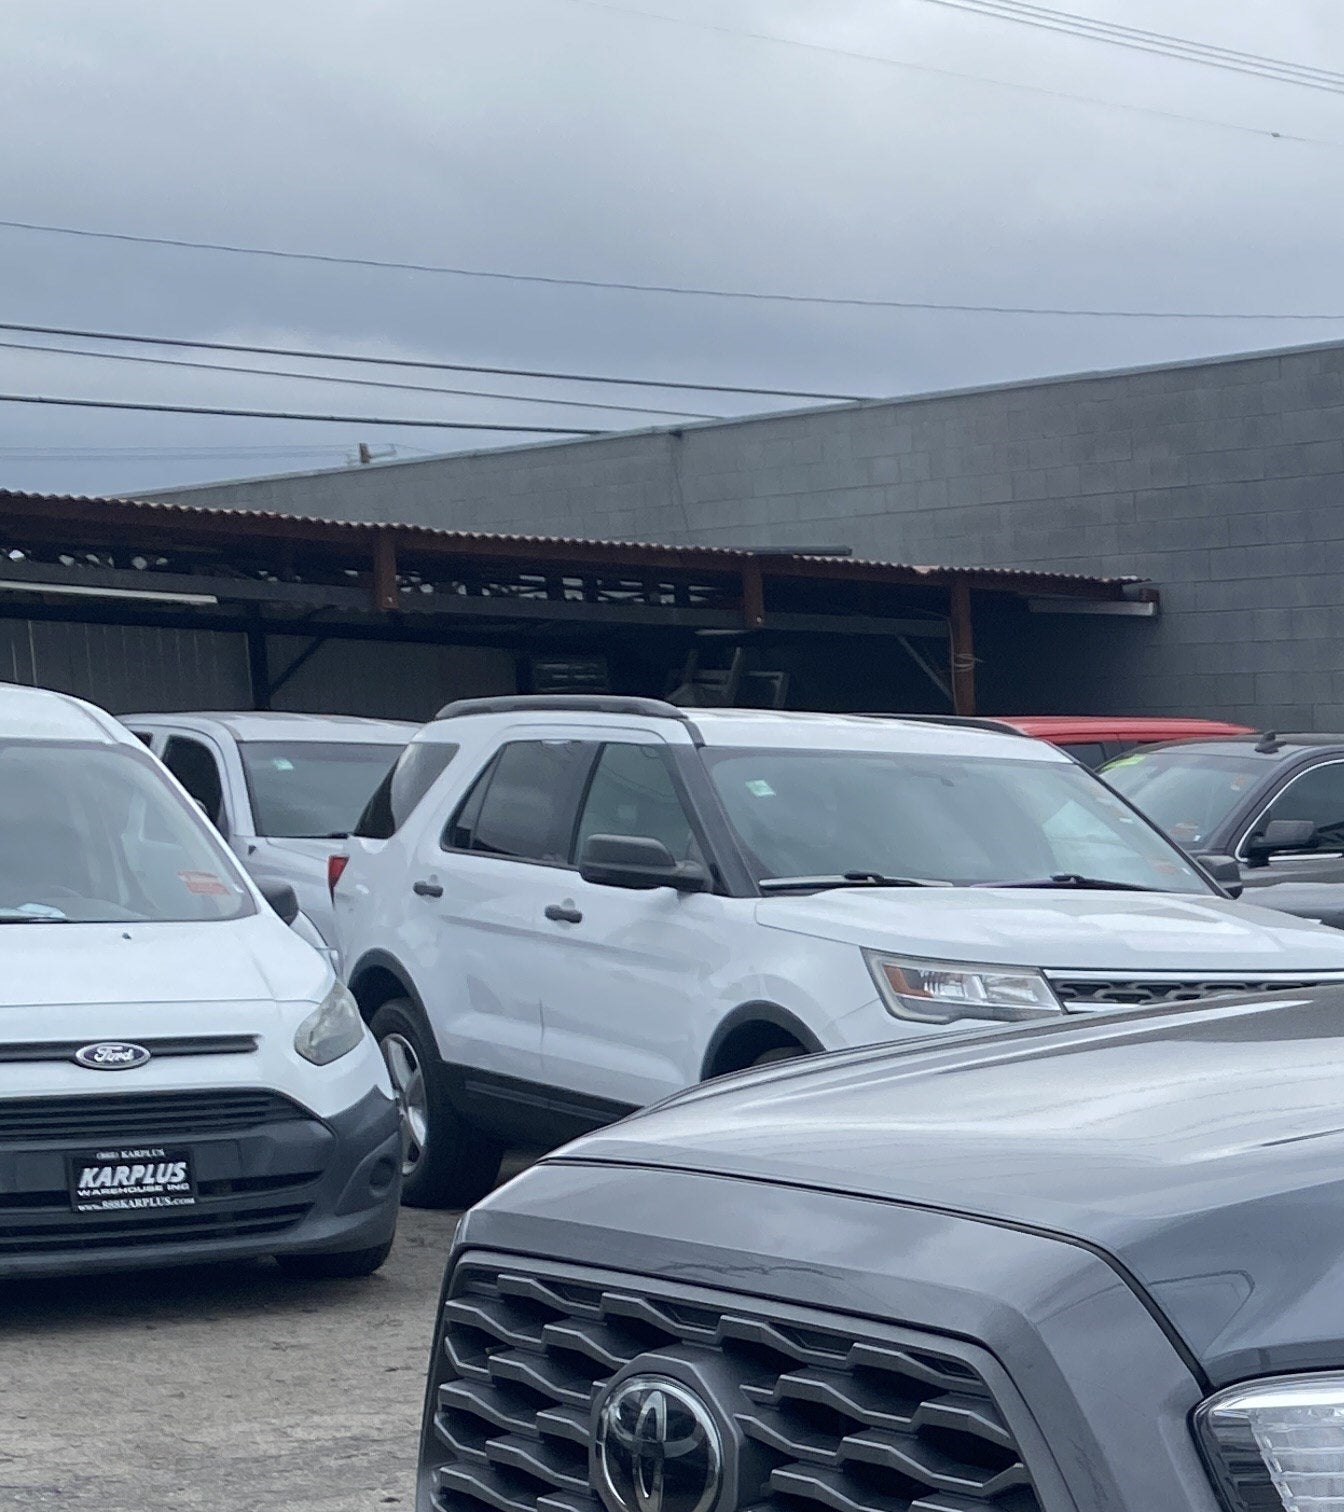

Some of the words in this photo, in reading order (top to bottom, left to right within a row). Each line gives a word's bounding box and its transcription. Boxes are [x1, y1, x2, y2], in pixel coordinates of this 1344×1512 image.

[94, 1046, 135, 1064] Ford
[79, 1162, 187, 1188] KARPLUS
[77, 1185, 164, 1197] WAREHOUSE
[167, 1183, 190, 1191] INC
